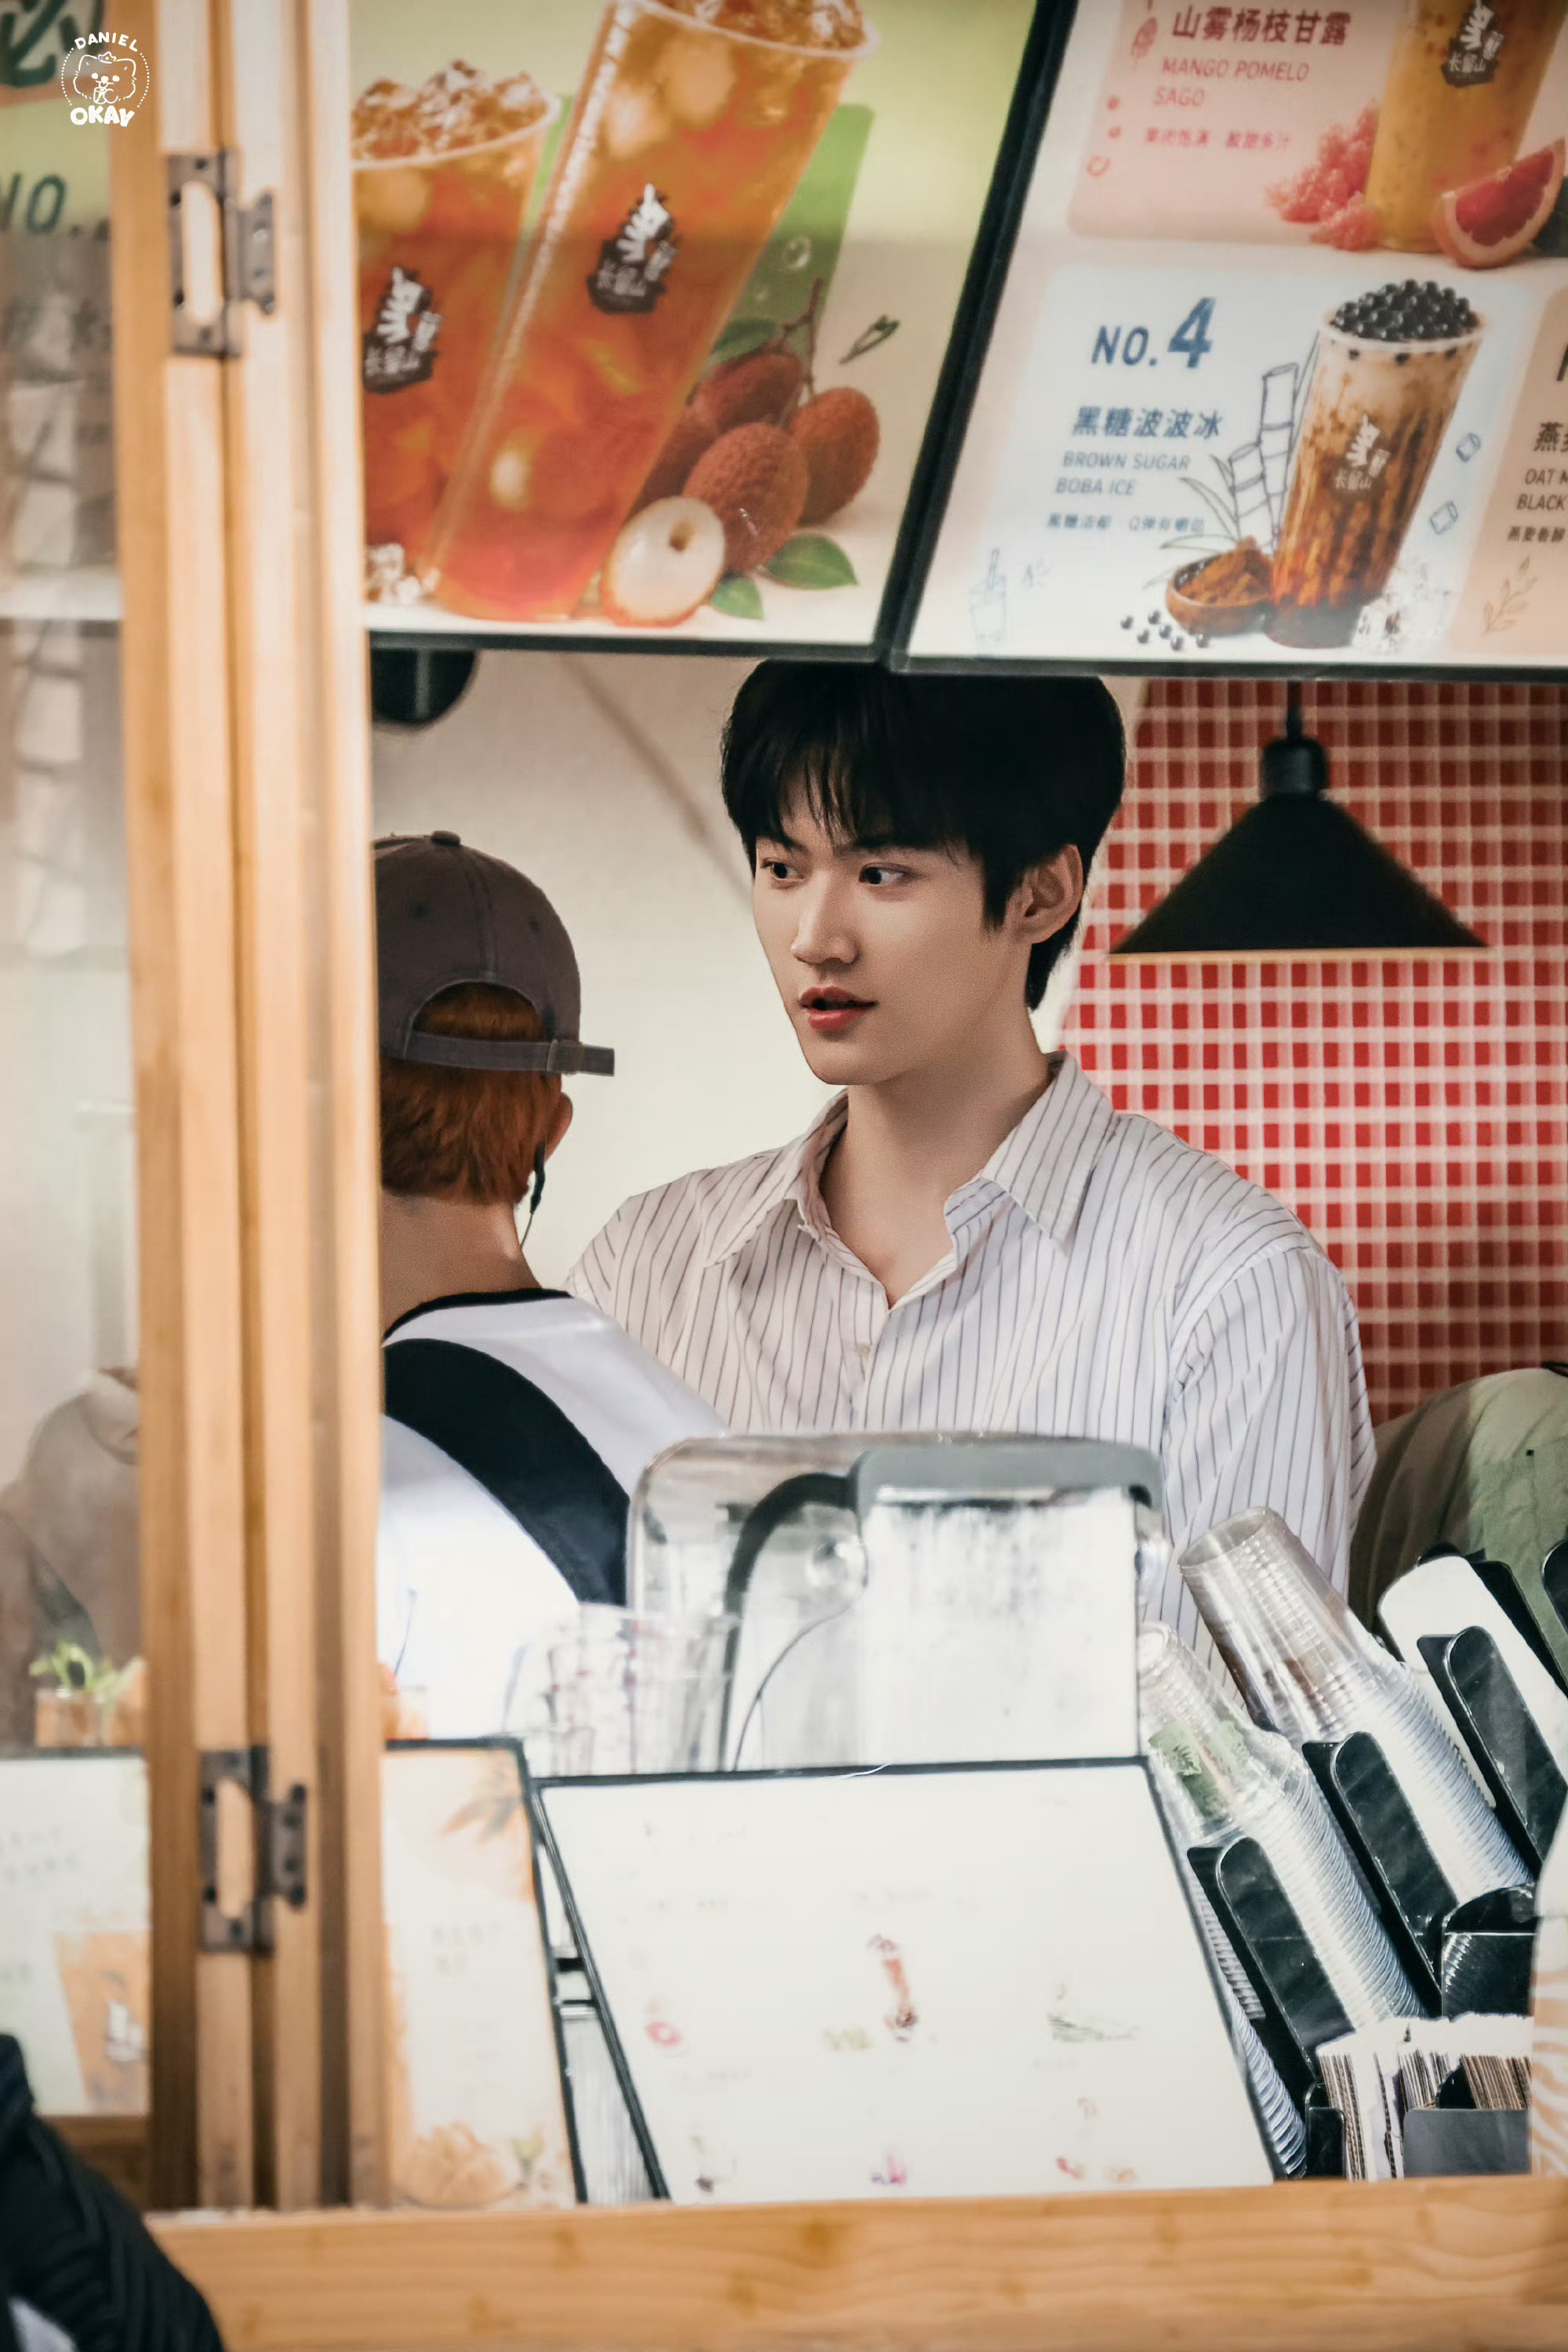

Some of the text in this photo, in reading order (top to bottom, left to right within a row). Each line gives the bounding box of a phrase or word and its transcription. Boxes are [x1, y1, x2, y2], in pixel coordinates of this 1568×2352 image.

[1172, 5, 1352, 45] 山雾杨枝甘露
[1162, 58, 1309, 81] MANGO POMELO
[1154, 86, 1205, 107] SAGO
[1091, 296, 1217, 368] NO. 4
[1063, 451, 1190, 470] BROWN SUGAR
[1055, 477, 1136, 495] BOBA ICE
[1524, 469, 1555, 485] OAT
[1516, 494, 1566, 510] BLACK
